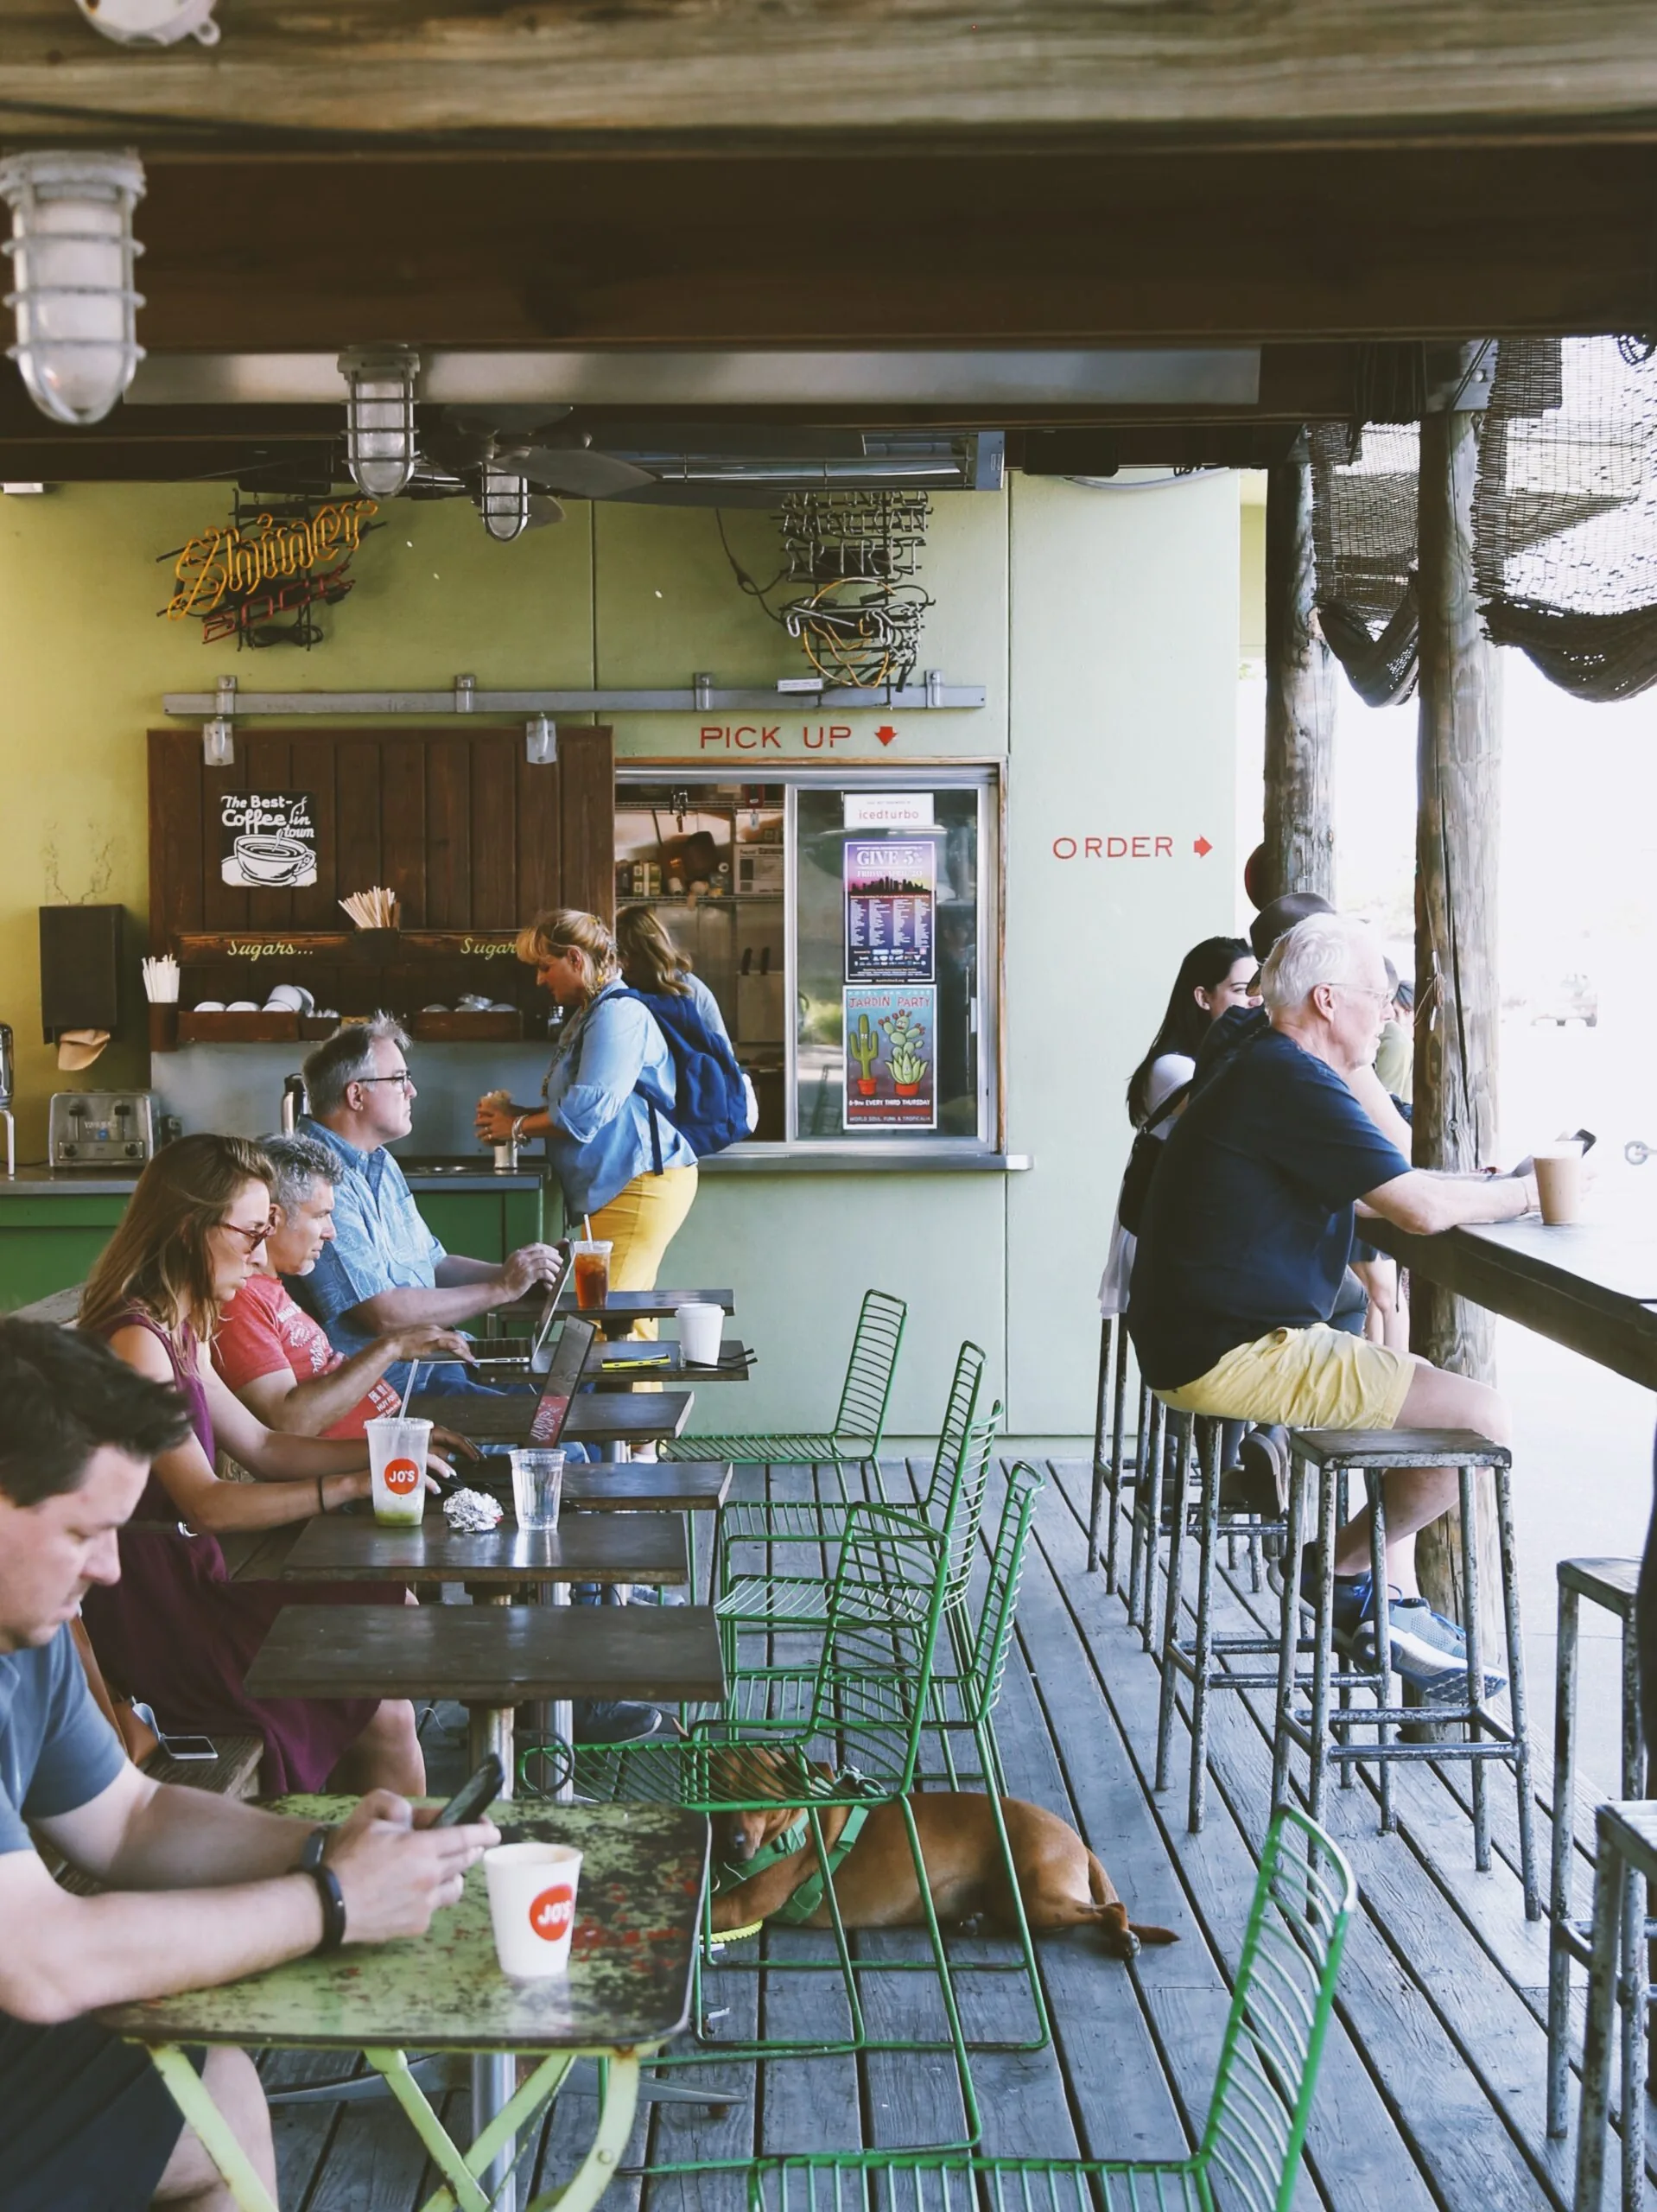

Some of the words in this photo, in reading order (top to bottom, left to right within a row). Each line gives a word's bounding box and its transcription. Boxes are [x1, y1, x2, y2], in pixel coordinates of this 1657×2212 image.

[168, 499, 378, 622] Shiner
[701, 727, 781, 749] PICK
[803, 727, 852, 748] UP
[221, 796, 247, 809] The
[222, 809, 287, 835] Coffee
[293, 811, 311, 825] in
[859, 810, 919, 820] icedturbo
[283, 824, 314, 838] town
[1052, 836, 1173, 860] ORDER
[857, 851, 898, 865] GIVE
[903, 851, 923, 865] 5%
[460, 938, 517, 961] Sugar
[849, 996, 891, 1008] JARDIN
[898, 996, 930, 1007] PARTY
[389, 1470, 415, 1484] JO'S
